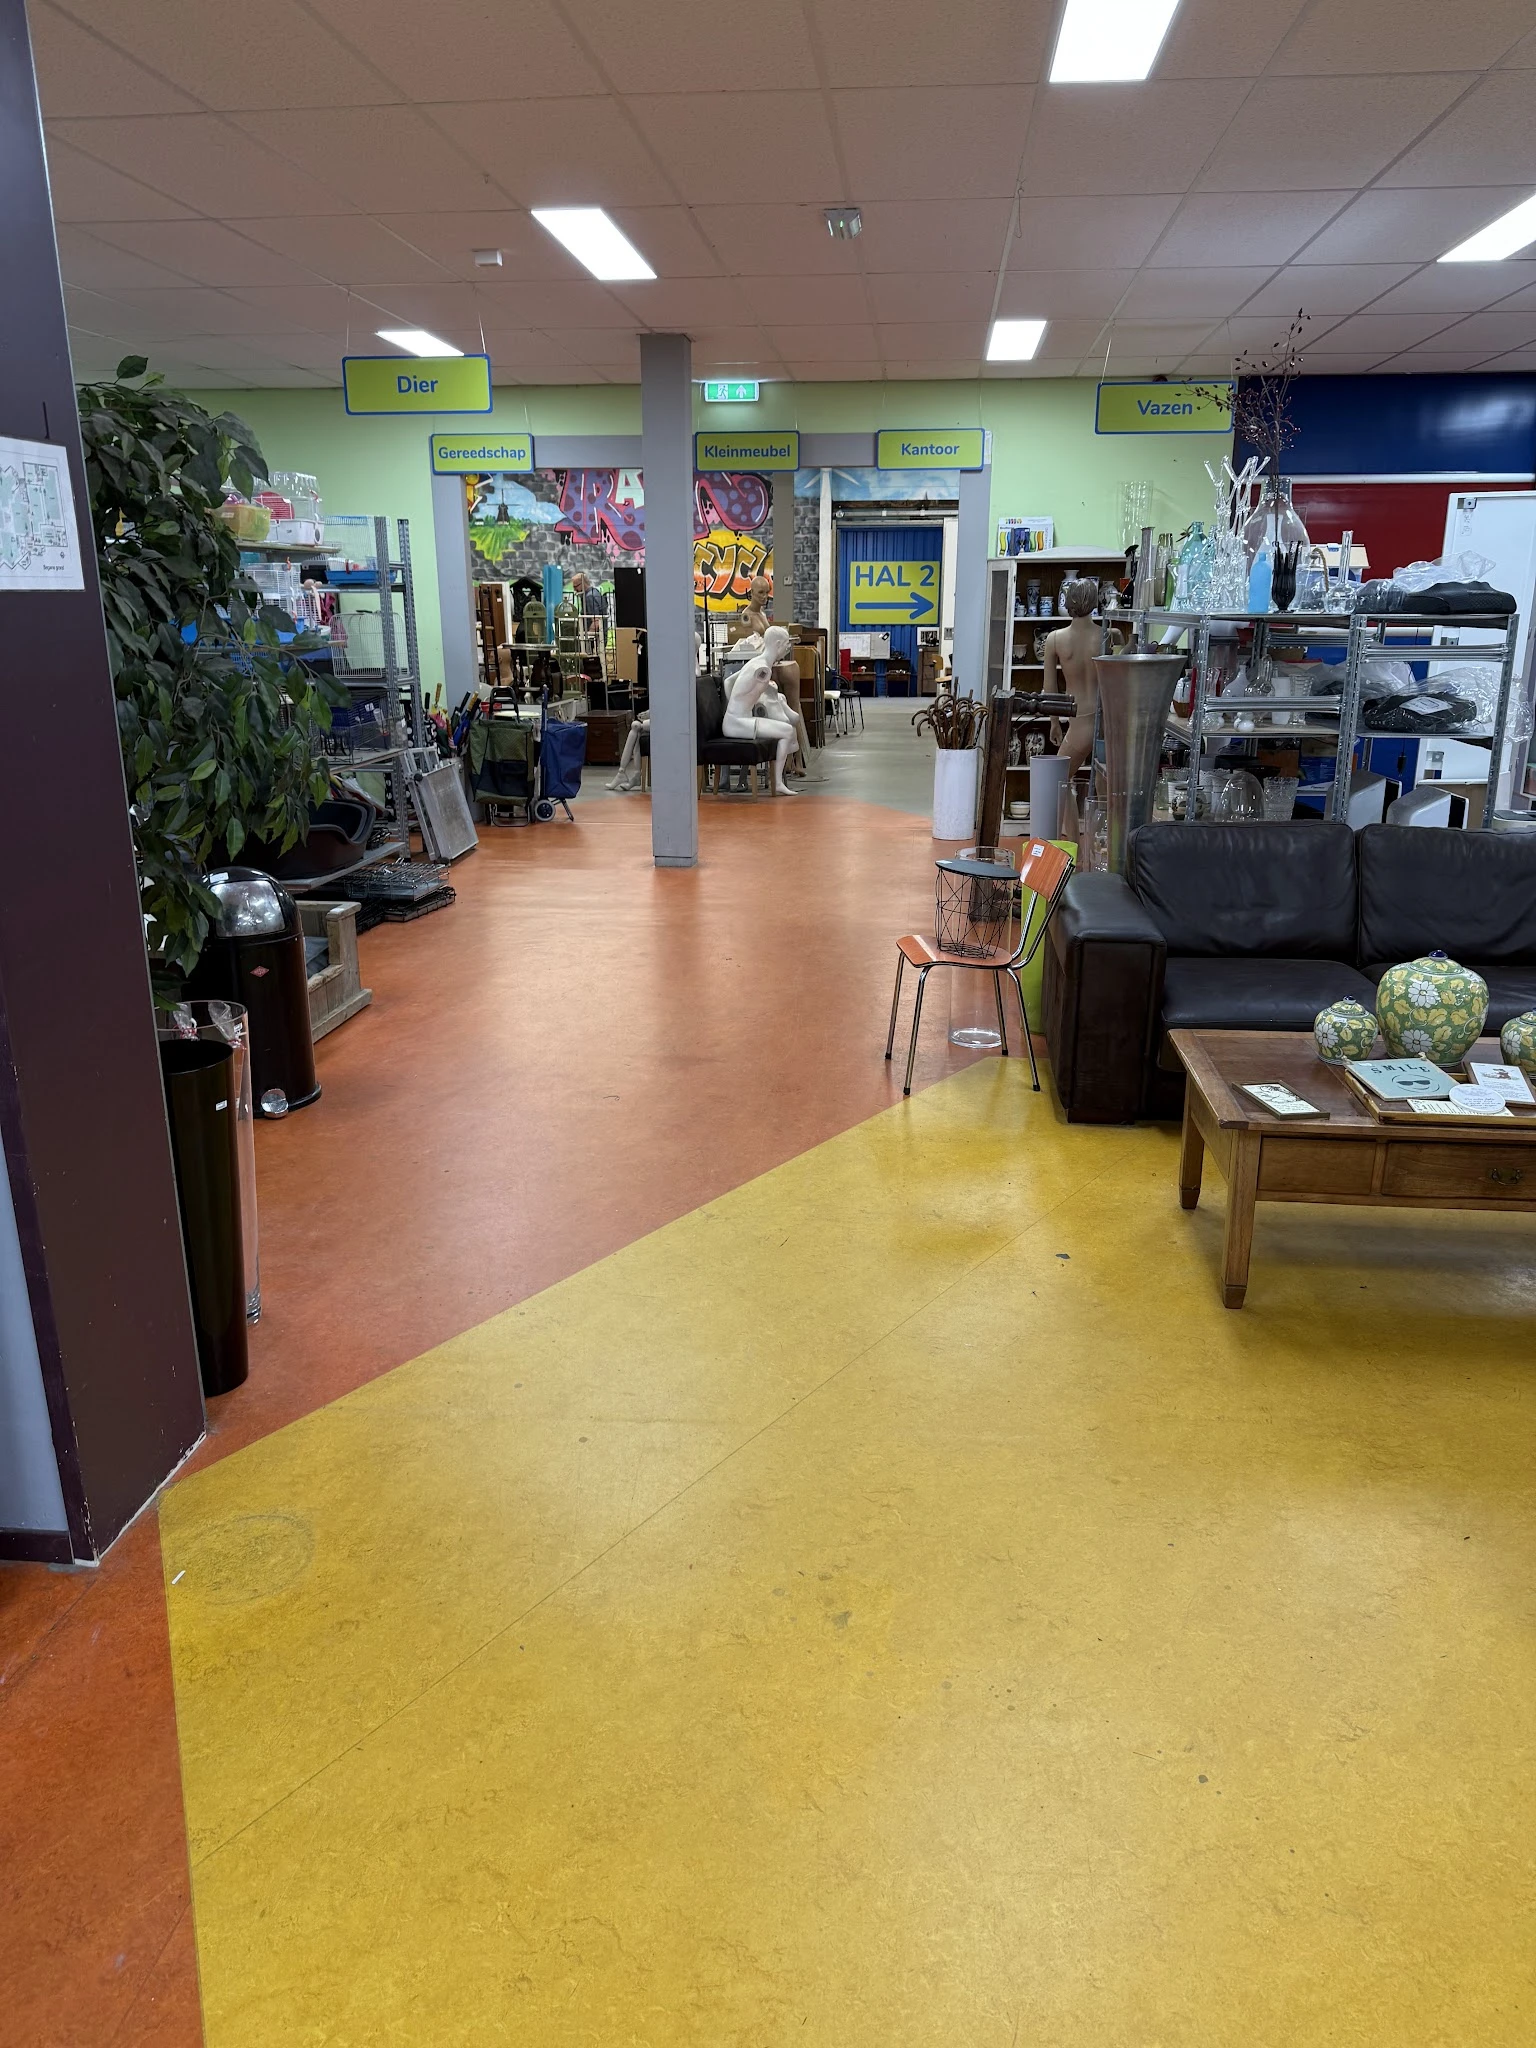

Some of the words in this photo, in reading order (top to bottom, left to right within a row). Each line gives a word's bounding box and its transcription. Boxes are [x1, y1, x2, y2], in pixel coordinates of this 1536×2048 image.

[397, 375, 439, 393] Dier
[1137, 400, 1193, 415] Vazen
[438, 446, 527, 461] Gereedschap
[704, 444, 790, 458] Kleinmeubel
[901, 443, 960, 456] Kantoor
[855, 565, 911, 587] HAL
[919, 565, 935, 587] 2
[1371, 1063, 1431, 1074] SMILE
